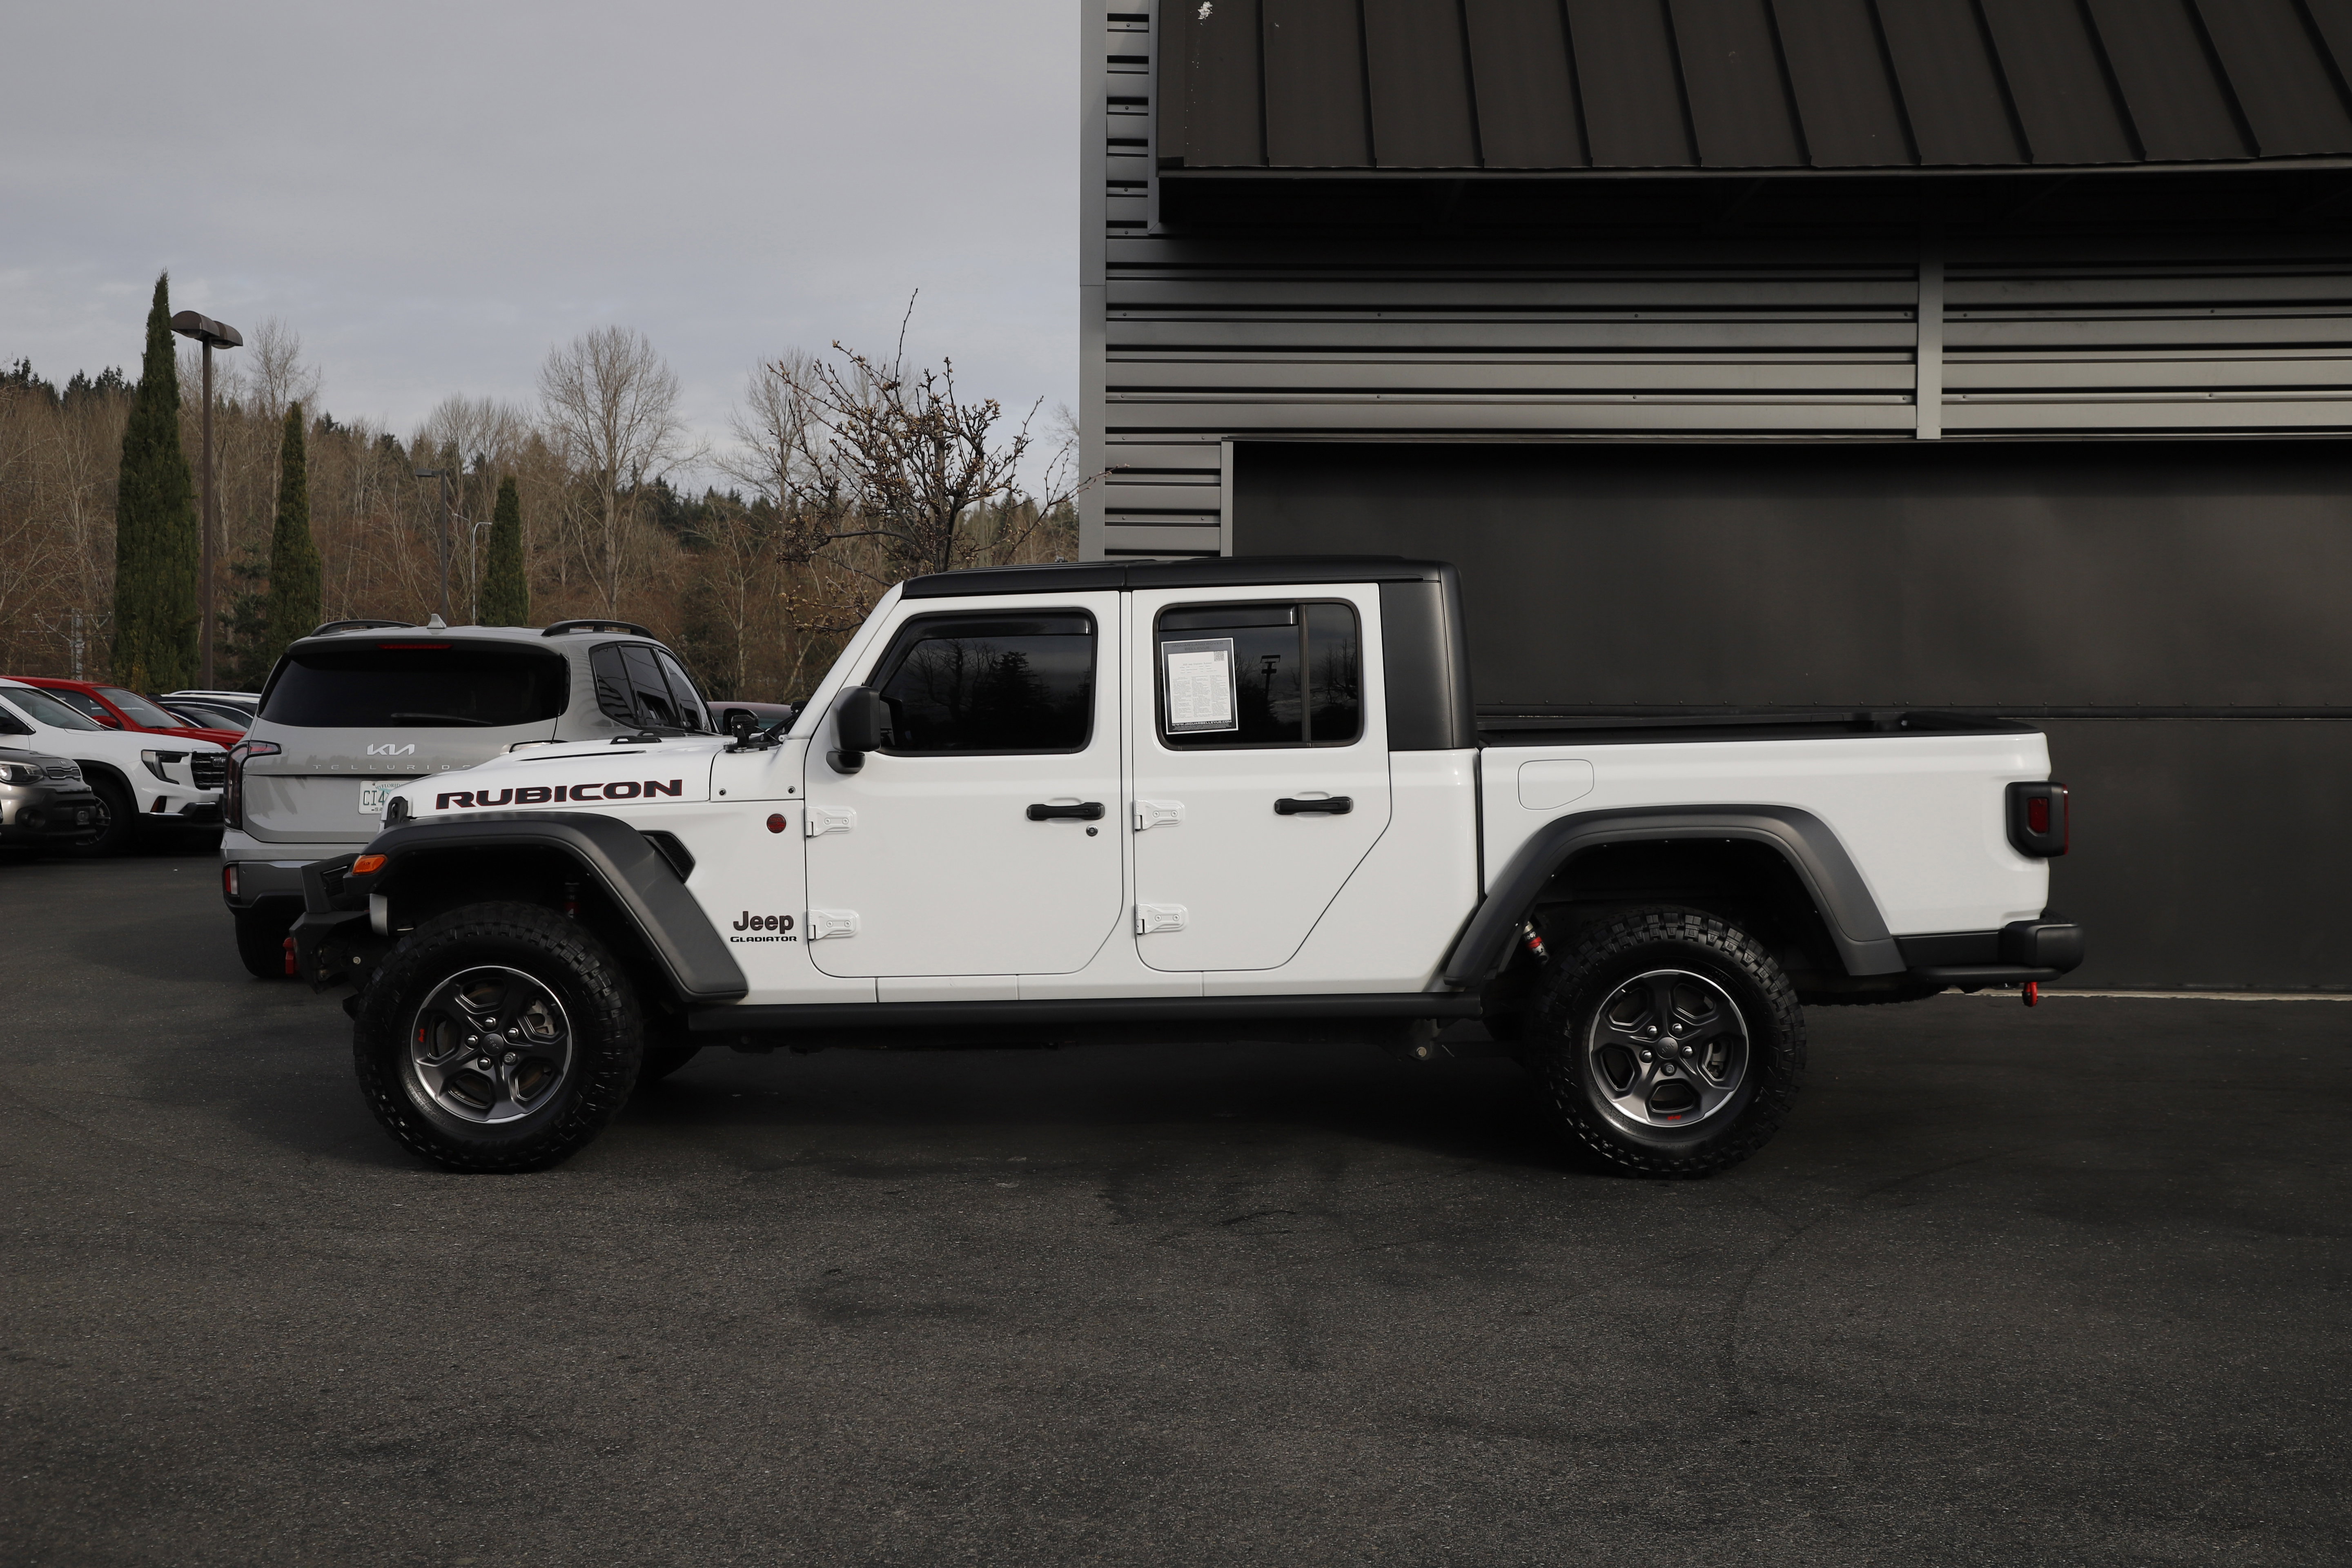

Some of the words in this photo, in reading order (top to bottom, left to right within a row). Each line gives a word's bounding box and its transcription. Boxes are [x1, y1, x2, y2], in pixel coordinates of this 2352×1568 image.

[367, 744, 415, 755] KIA
[436, 779, 682, 810] RUBICON
[733, 911, 794, 934] Jeep
